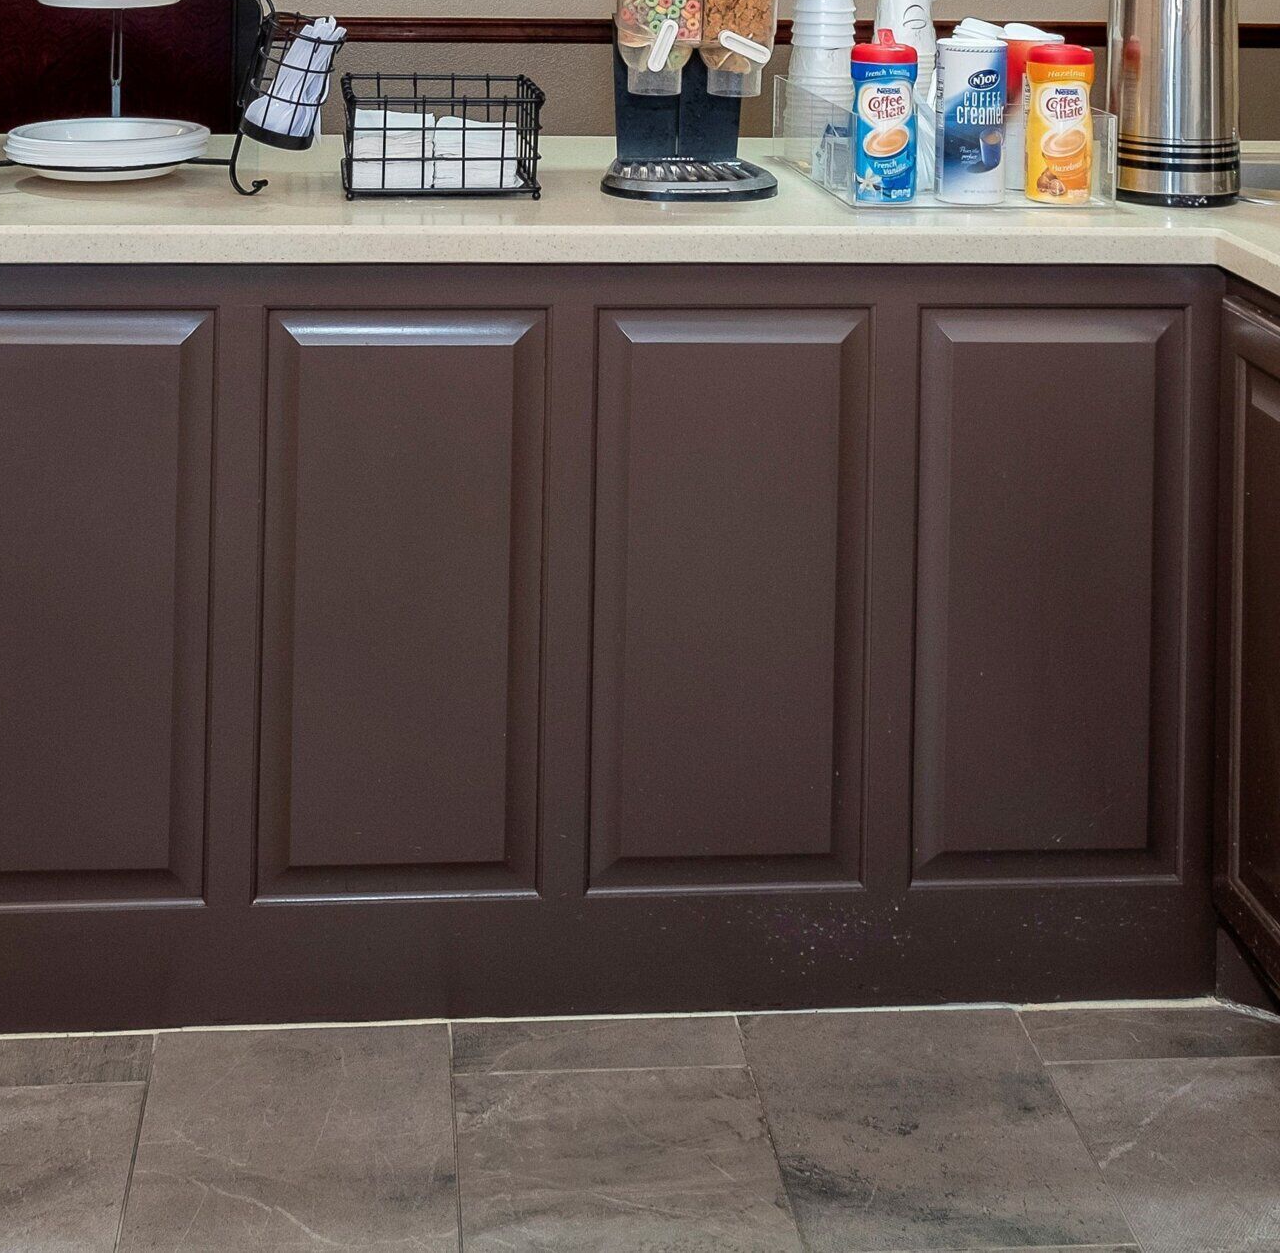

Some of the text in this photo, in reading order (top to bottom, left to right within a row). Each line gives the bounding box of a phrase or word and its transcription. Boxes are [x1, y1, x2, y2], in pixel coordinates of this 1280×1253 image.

[865, 68, 910, 78] French Vanilla
[964, 91, 1001, 106] COFFEE
[876, 105, 906, 120] mate
[874, 159, 898, 169] French
